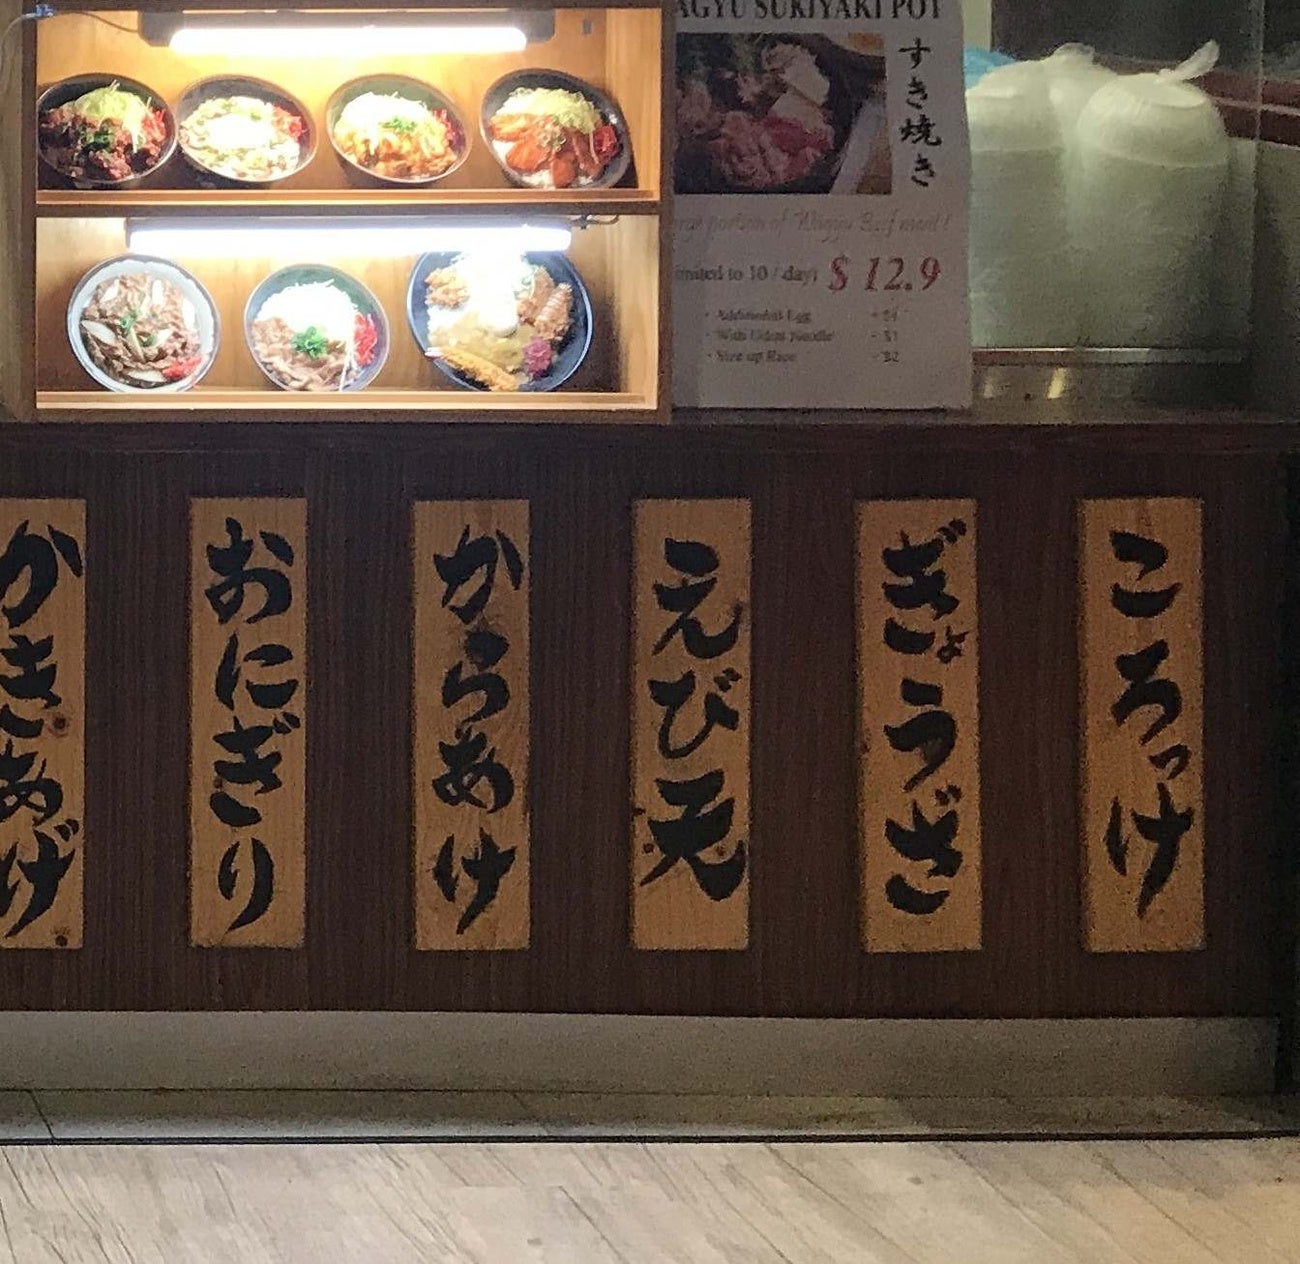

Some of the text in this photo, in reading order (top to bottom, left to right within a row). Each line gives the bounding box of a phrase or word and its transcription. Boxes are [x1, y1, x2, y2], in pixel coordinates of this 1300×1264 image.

[828, 254, 942, 292] $ 12.9
[204, 517, 300, 934] おにぎり
[641, 537, 747, 903] えび天
[880, 518, 970, 917] ぎょうざ
[1105, 530, 1196, 919] ころっけ
